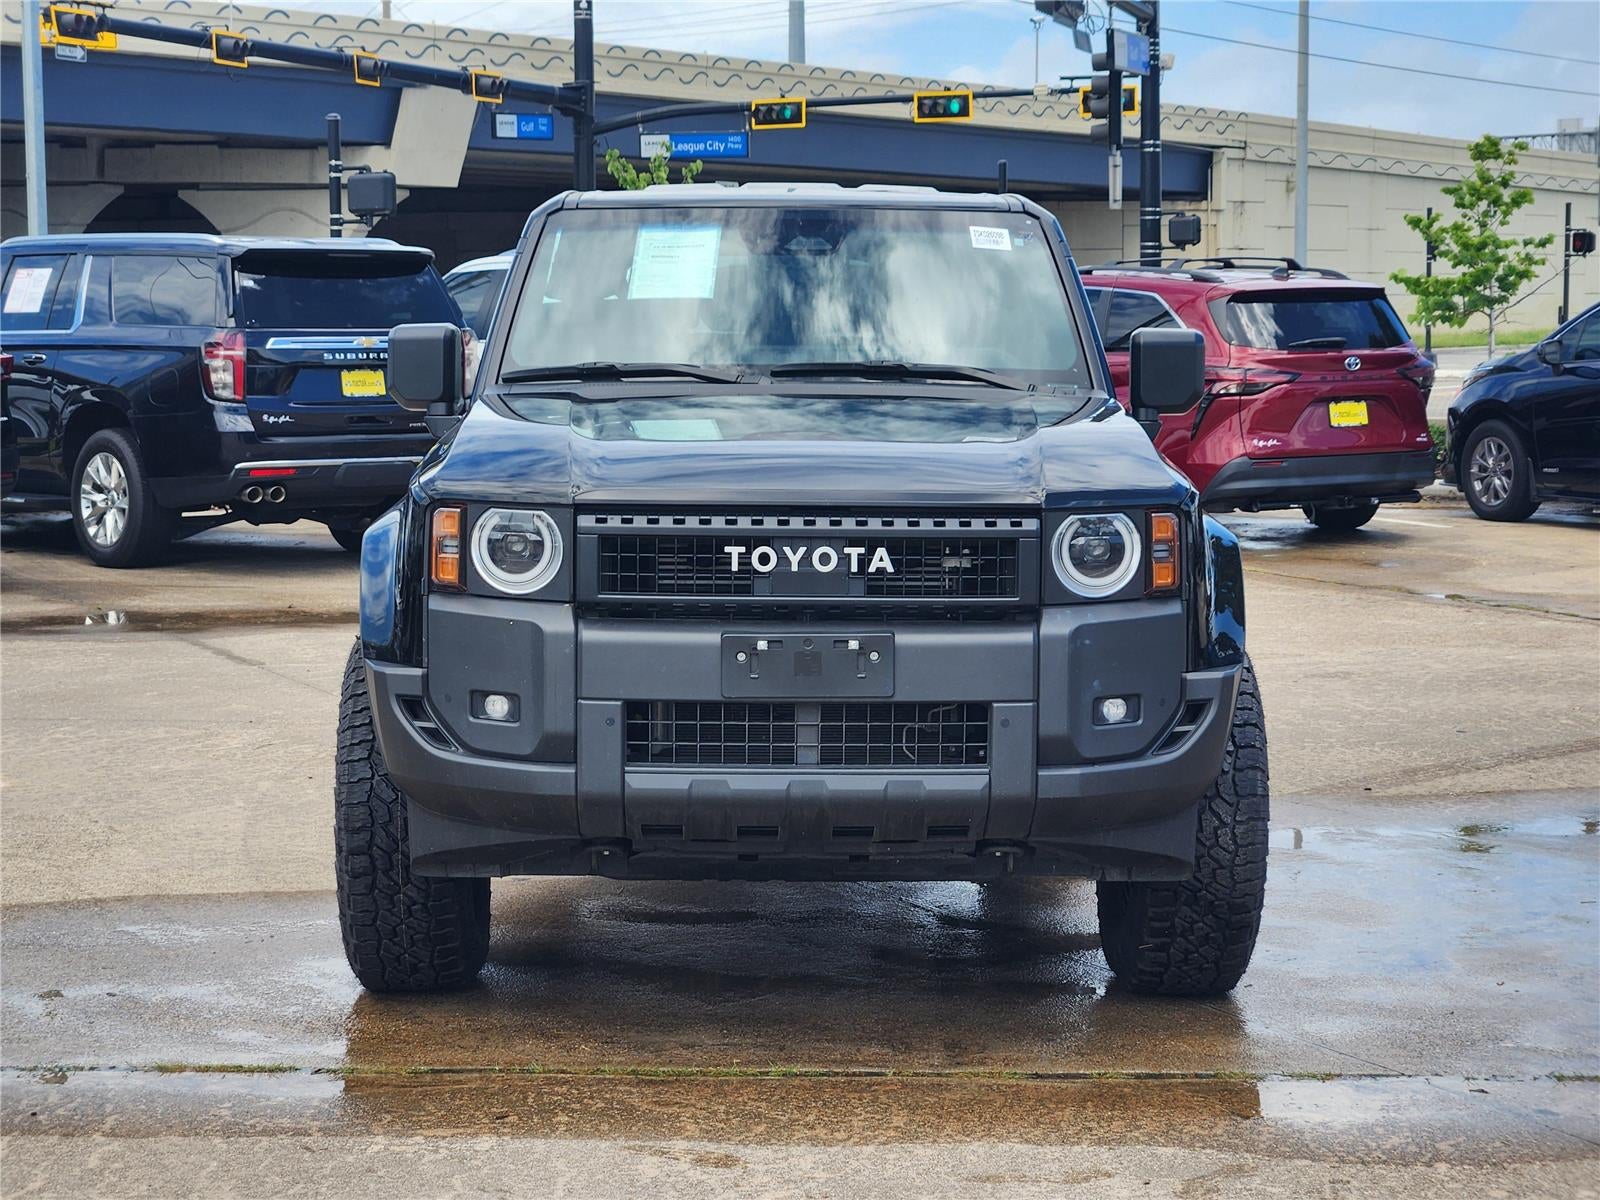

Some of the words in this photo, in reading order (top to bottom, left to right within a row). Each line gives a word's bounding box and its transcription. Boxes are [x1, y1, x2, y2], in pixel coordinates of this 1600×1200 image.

[520, 121, 534, 132] Gulf
[672, 141, 705, 154] League
[706, 140, 726, 152] City
[323, 352, 389, 360] SUBURB
[724, 545, 895, 573] TOYOTA
